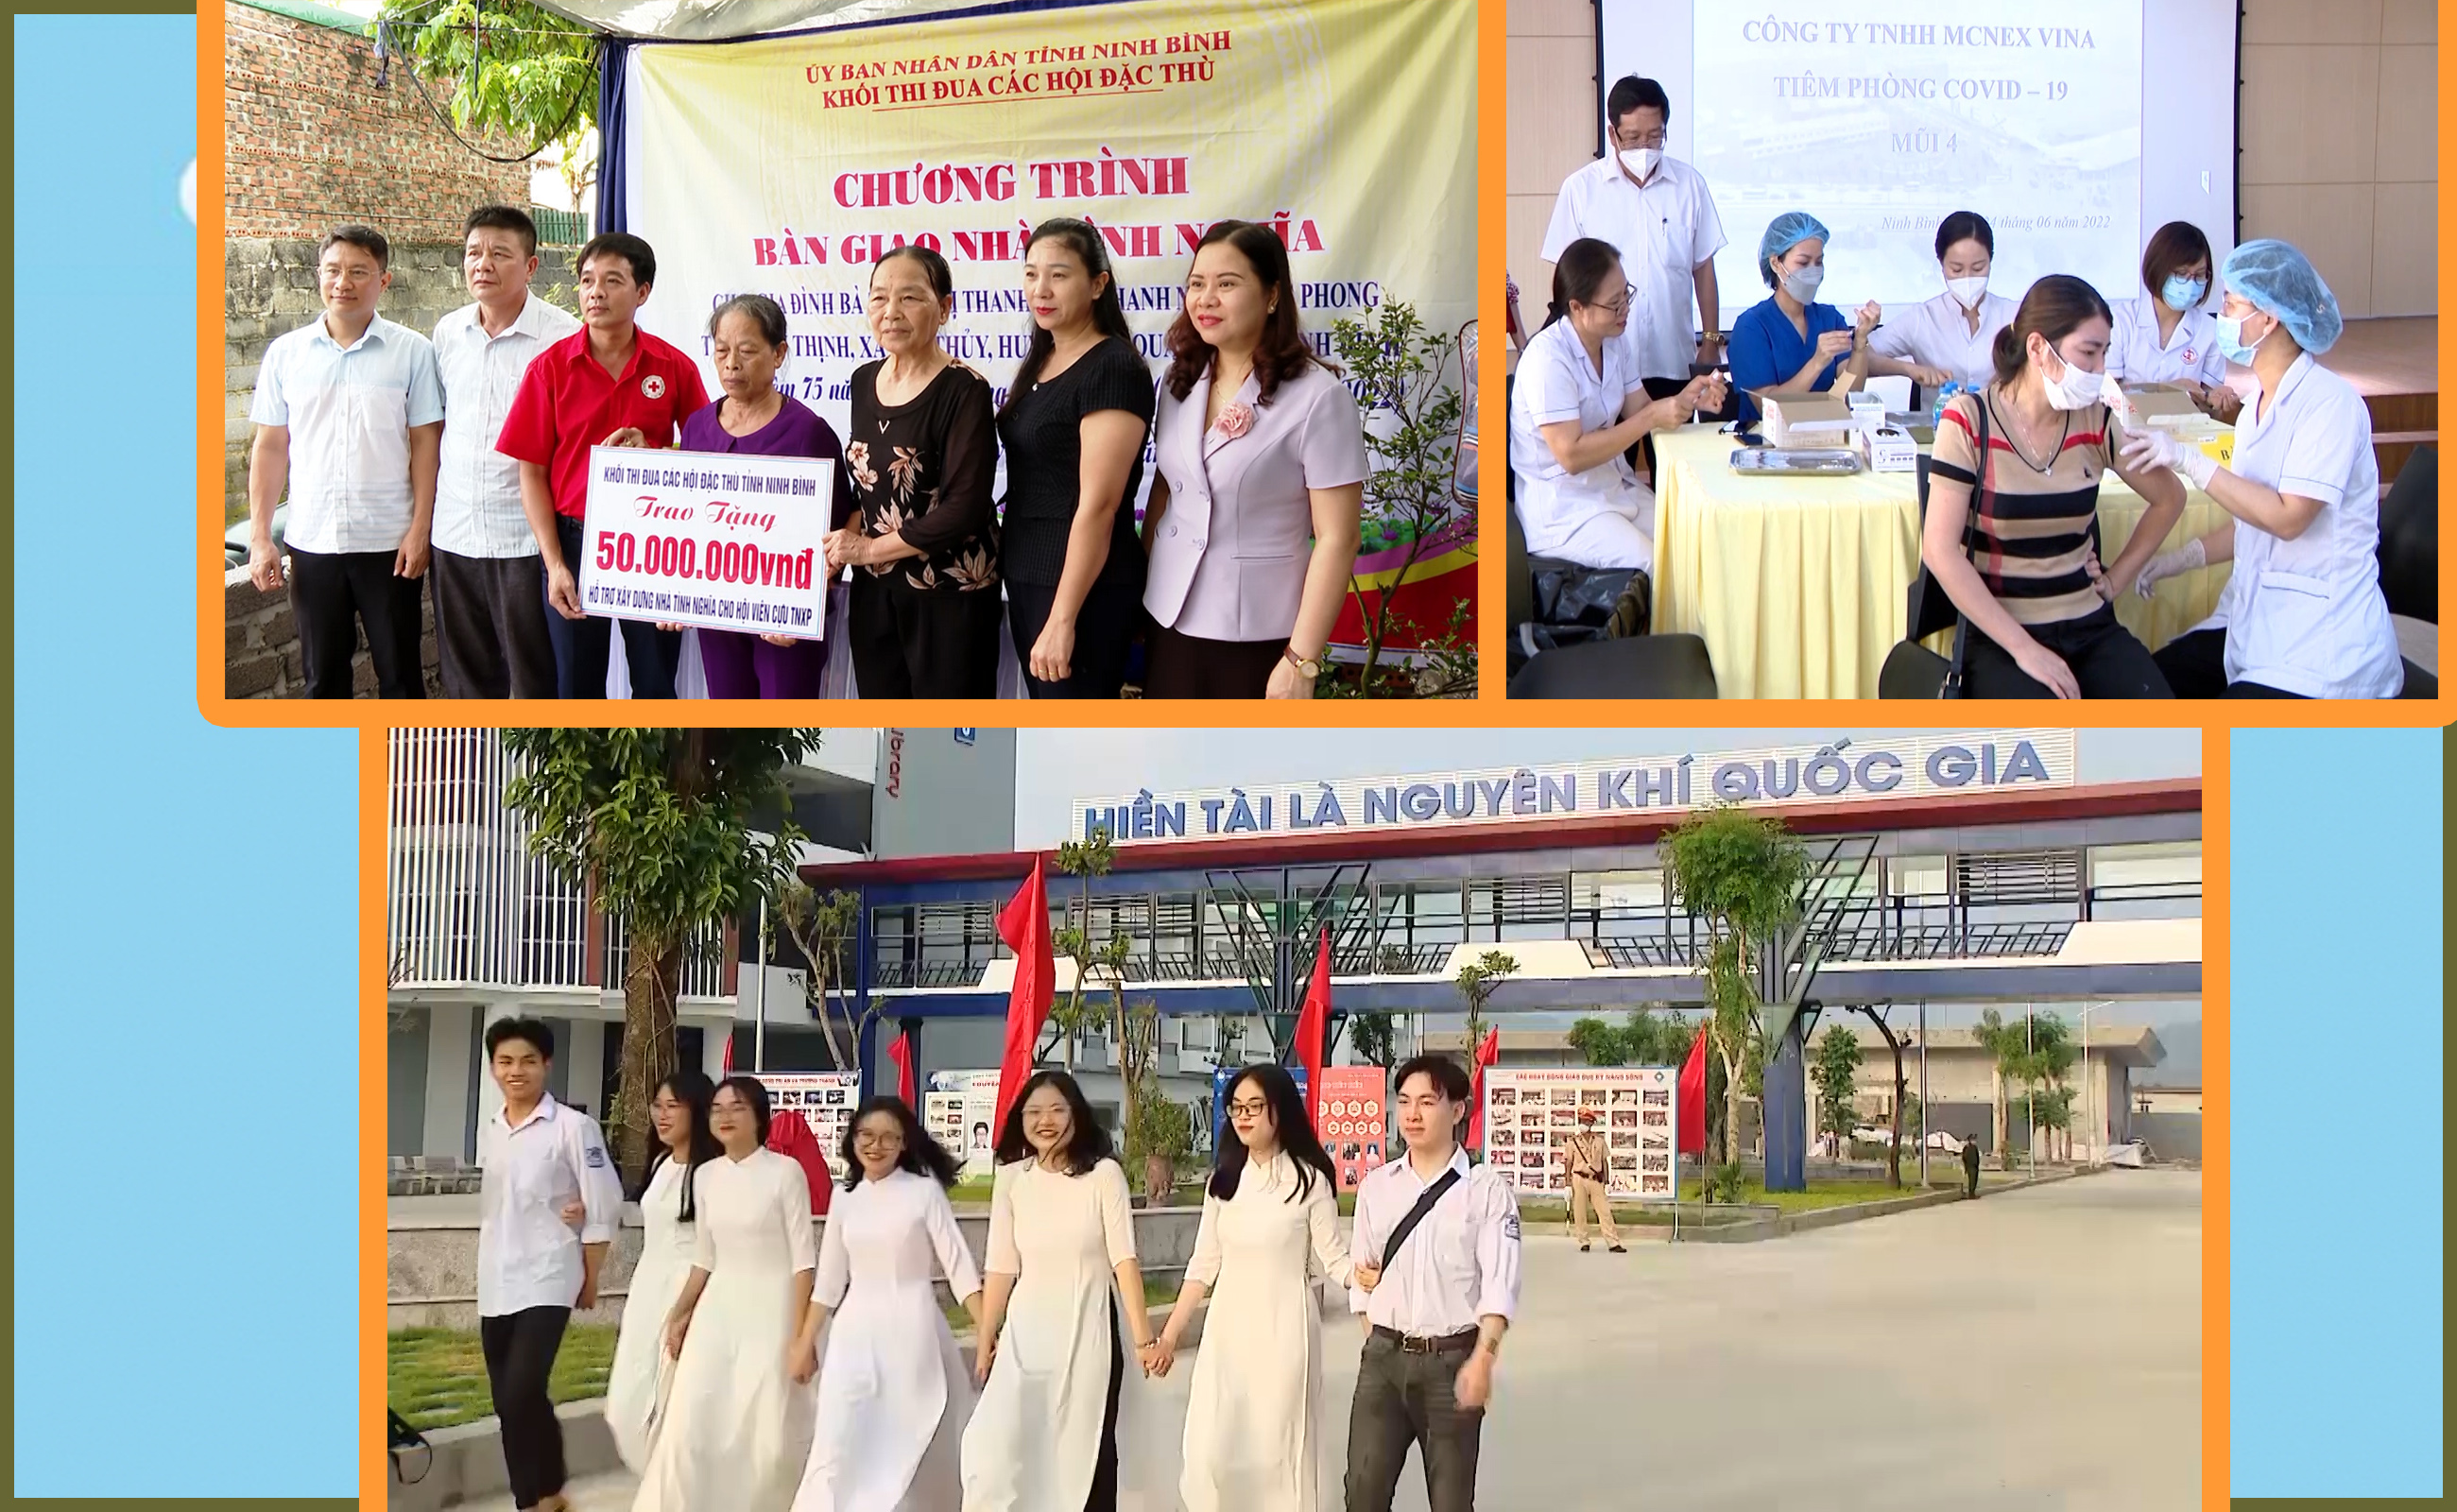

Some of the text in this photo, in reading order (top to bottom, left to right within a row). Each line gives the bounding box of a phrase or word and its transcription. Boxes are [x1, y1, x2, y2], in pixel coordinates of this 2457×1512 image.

[1743, 13, 2096, 49] CÔNG TY TNHH MCNEX VINA
[841, 60, 887, 81] BAN
[892, 51, 960, 77] NHÂN
[965, 47, 1018, 70] DÂN
[1091, 38, 1158, 60] NINH
[1165, 30, 1231, 56] BÌNH
[823, 55, 1215, 109] KHỐI THI ĐUA CÁC HỘI ĐẶC THÙ
[1773, 69, 1841, 97] TIÊM
[1847, 71, 1936, 99] PHÒNG
[1943, 77, 2022, 100] COVID
[2047, 80, 2069, 101] 19
[1891, 127, 1958, 153] MŨI 4
[833, 146, 1190, 209] CHƯƠNG TRÌNH
[752, 227, 830, 266] BÀN
[840, 232, 941, 265] GIAO
[952, 218, 1032, 262] NHÀ
[1175, 210, 1325, 256] NĨA
[1881, 216, 1912, 230] Ninh
[2001, 215, 2033, 232] tháng
[2036, 215, 2052, 229] 06
[2053, 215, 2079, 229] năm
[2082, 215, 2111, 229] 2022
[790, 286, 833, 315] ĐÌNH
[840, 285, 864, 315] BÀ
[962, 289, 1032, 313] THANH
[1300, 281, 1380, 309] PHONG
[802, 376, 824, 401] 75
[603, 462, 625, 484] KHỐI
[627, 468, 641, 485] THI
[642, 469, 660, 486] ĐUA
[662, 467, 680, 488] CÁC
[682, 468, 698, 492] HỘI
[721, 471, 739, 491] THÙ
[742, 469, 764, 493] TỈNH
[765, 476, 790, 495] NINH
[792, 474, 816, 497] BÌNH
[634, 495, 778, 533] Trao Tặng
[595, 530, 815, 591] 50.000.000vnđ
[601, 586, 615, 610] TRỢ
[616, 585, 631, 608] XÂY
[632, 589, 654, 612] DỰNG
[655, 590, 671, 611] NHÀ
[674, 591, 691, 614] TÌNH
[692, 594, 716, 616] NGHĨA
[718, 599, 734, 619] CHO
[736, 597, 750, 624] HỘI
[751, 600, 770, 623] VIÊN
[791, 607, 813, 627] TNXP
[1085, 737, 2051, 842] HIỀN TÀI LÀ NGUYÊN KHÍ QUỐC GIA
